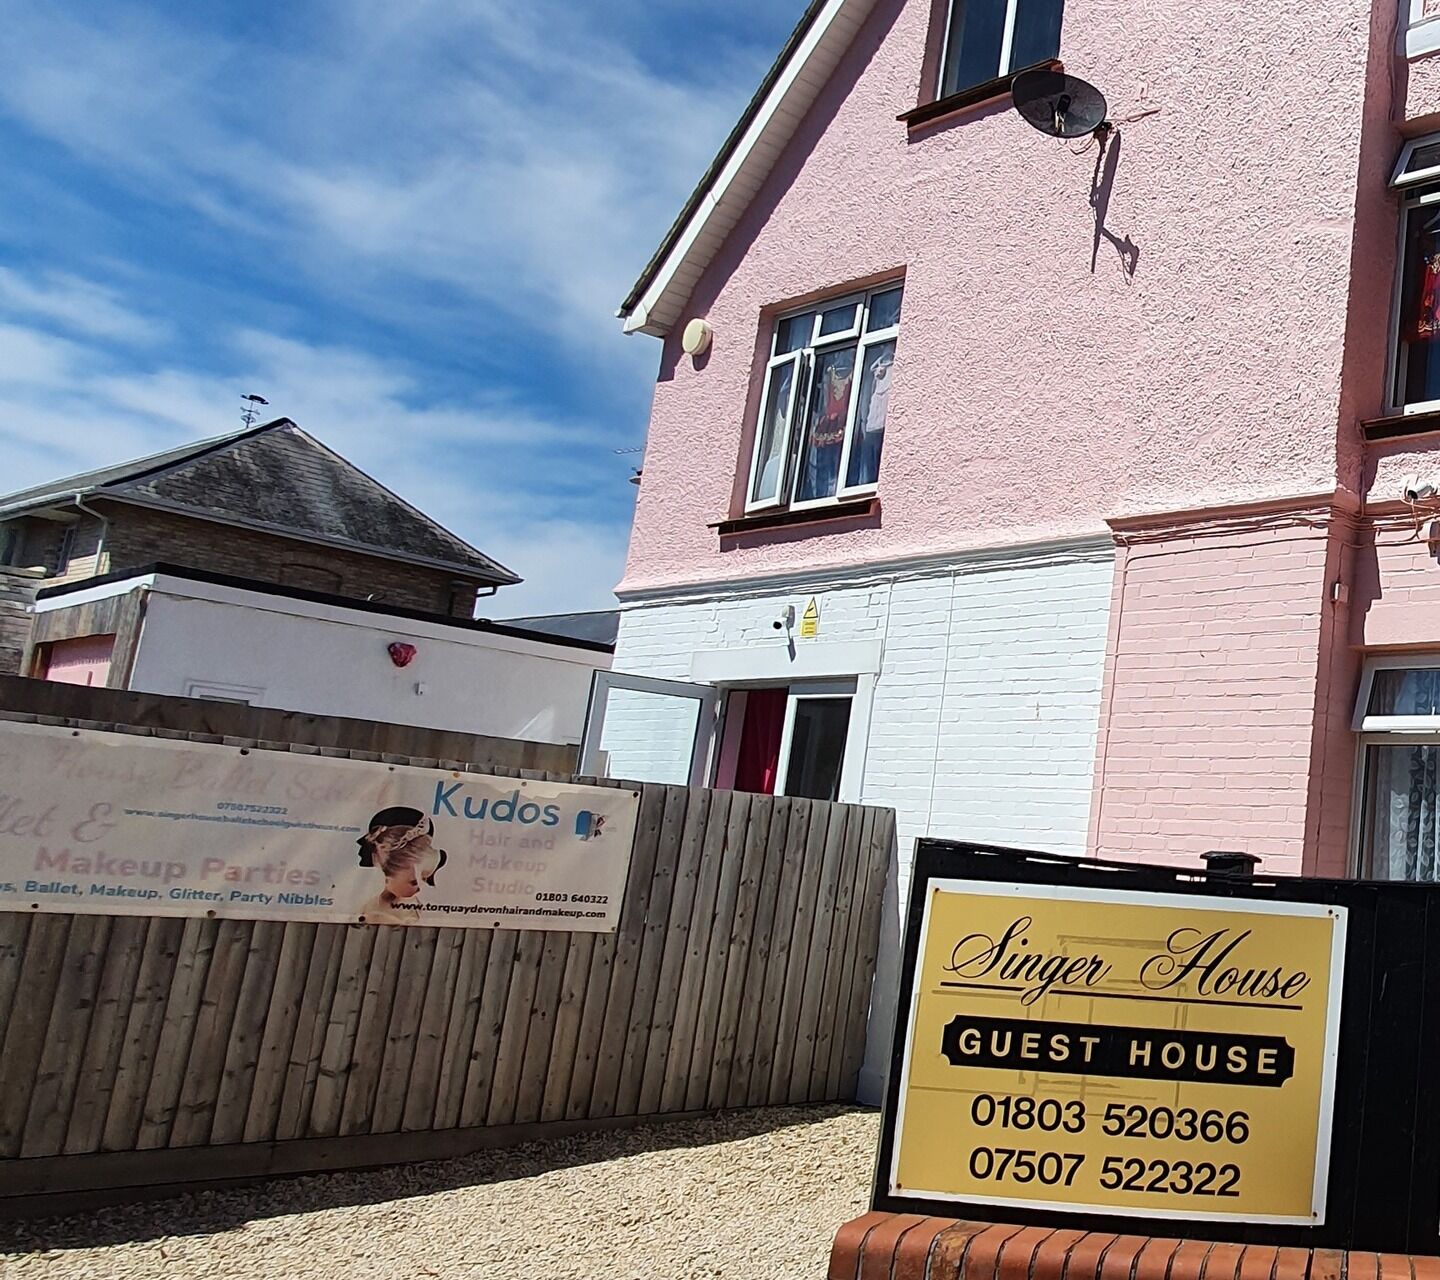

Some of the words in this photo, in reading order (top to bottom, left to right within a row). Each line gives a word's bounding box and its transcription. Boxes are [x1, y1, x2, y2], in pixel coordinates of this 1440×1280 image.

[432, 780, 561, 827] Kudos
[468, 828, 511, 848] Hair
[518, 833, 556, 851] and
[34, 845, 187, 885] Makeup
[201, 856, 322, 887] Parties
[468, 853, 547, 877] Makeup
[24, 879, 84, 897] Ballet,
[169, 887, 224, 903] Glitter,
[230, 889, 272, 905] Party
[277, 891, 334, 908] Nibbles
[471, 876, 535, 897] Studio
[535, 892, 568, 903] 01803
[570, 894, 609, 905] 640322
[391, 901, 606, 920] www.torquaydevonhairandmakeup.com
[942, 915, 1112, 1007] Singer
[1139, 927, 1312, 1001] House
[958, 1027, 1101, 1064] GUEST
[1129, 1039, 1279, 1076] HOUSE
[970, 1093, 1086, 1134] 01803
[1101, 1102, 1250, 1145] 520366
[968, 1146, 1086, 1187] 07507
[1099, 1155, 1242, 1198] 522322
